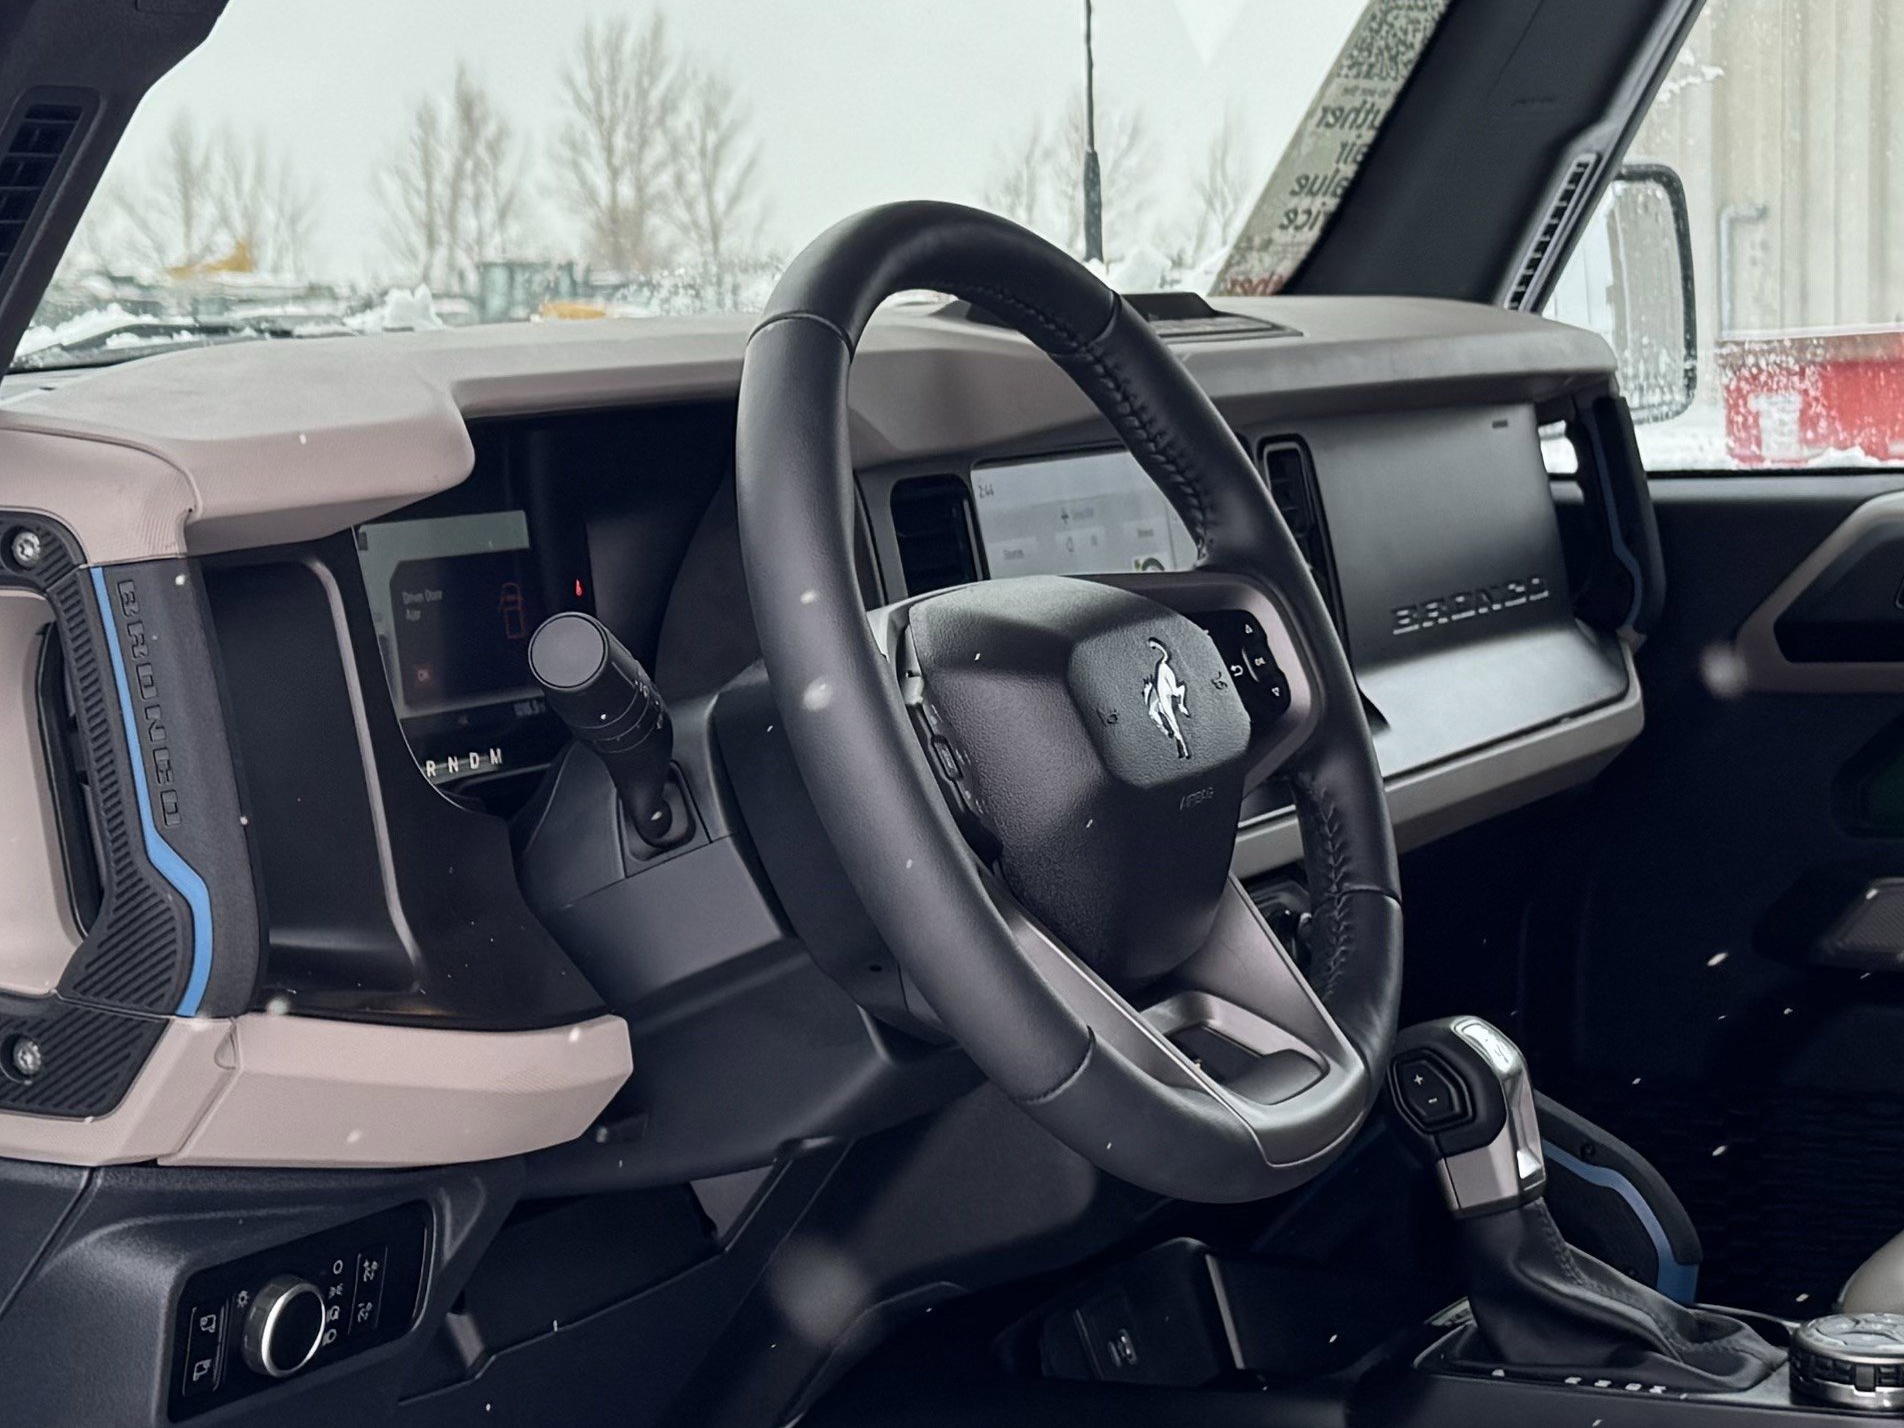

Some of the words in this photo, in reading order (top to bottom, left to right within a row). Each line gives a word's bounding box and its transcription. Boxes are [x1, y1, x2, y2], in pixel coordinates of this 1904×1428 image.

[1392, 576, 1550, 635] BRONCO
[118, 580, 180, 826] BRONCO
[426, 760, 436, 777] R
[448, 756, 459, 774] N
[469, 751, 480, 770] D
[489, 747, 503, 765] M
